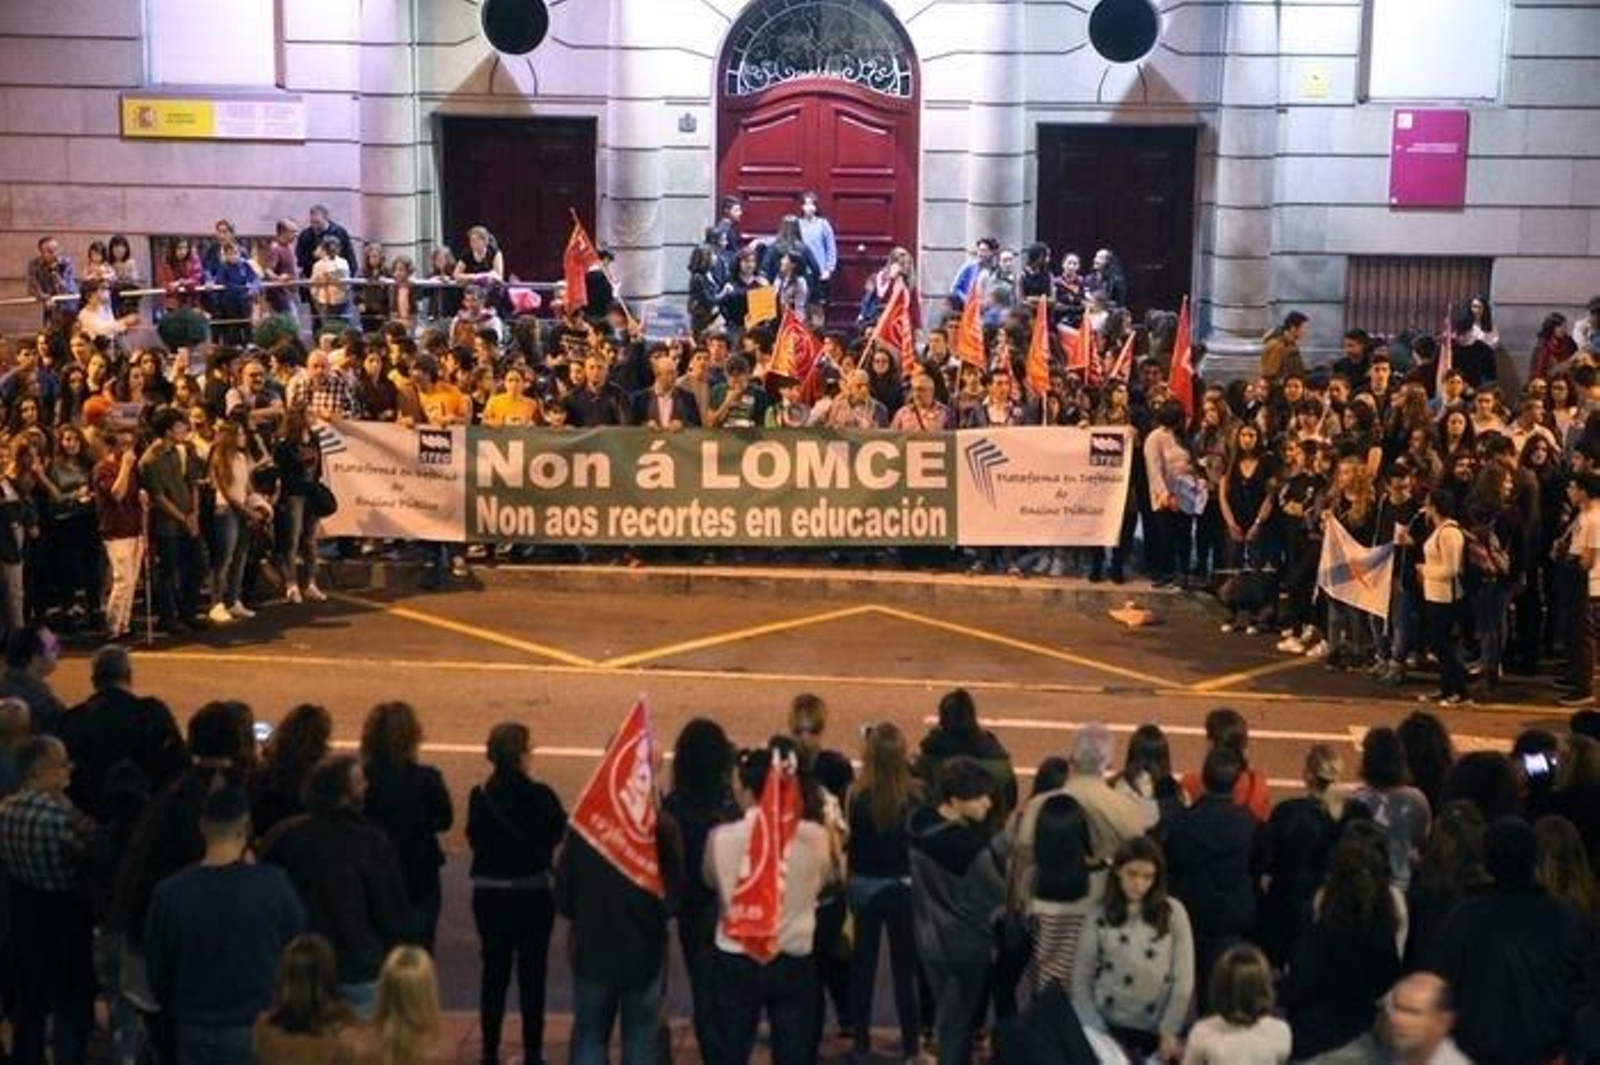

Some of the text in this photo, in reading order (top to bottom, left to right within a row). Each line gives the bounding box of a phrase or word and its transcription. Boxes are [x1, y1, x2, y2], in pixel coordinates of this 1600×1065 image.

[475, 438, 949, 489] Non á LOMCE
[476, 496, 947, 539] Non aos recortes en educación
